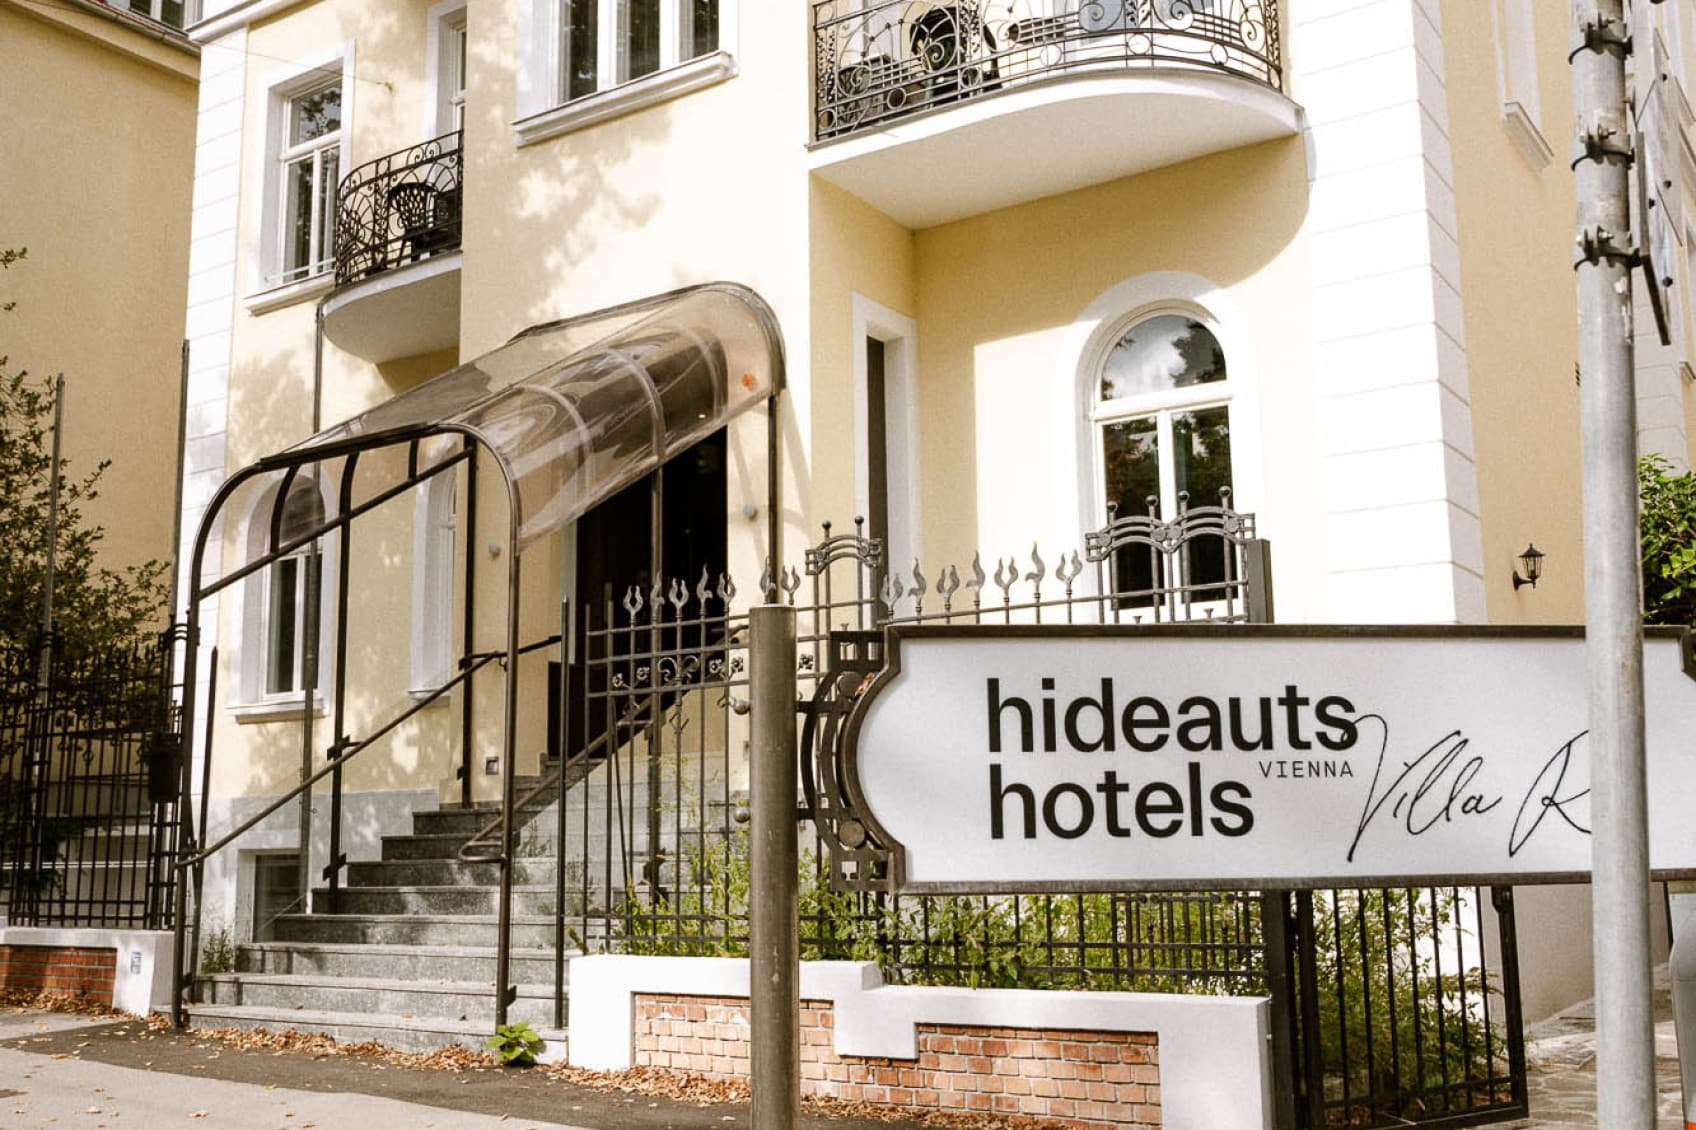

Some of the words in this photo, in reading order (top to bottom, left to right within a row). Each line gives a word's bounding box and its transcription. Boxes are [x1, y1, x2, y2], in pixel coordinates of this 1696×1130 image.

[987, 677, 1358, 754] hideauts
[990, 762, 1254, 840] hotels
[1259, 761, 1354, 779] VIENNA
[1340, 714, 1502, 862] Villa
